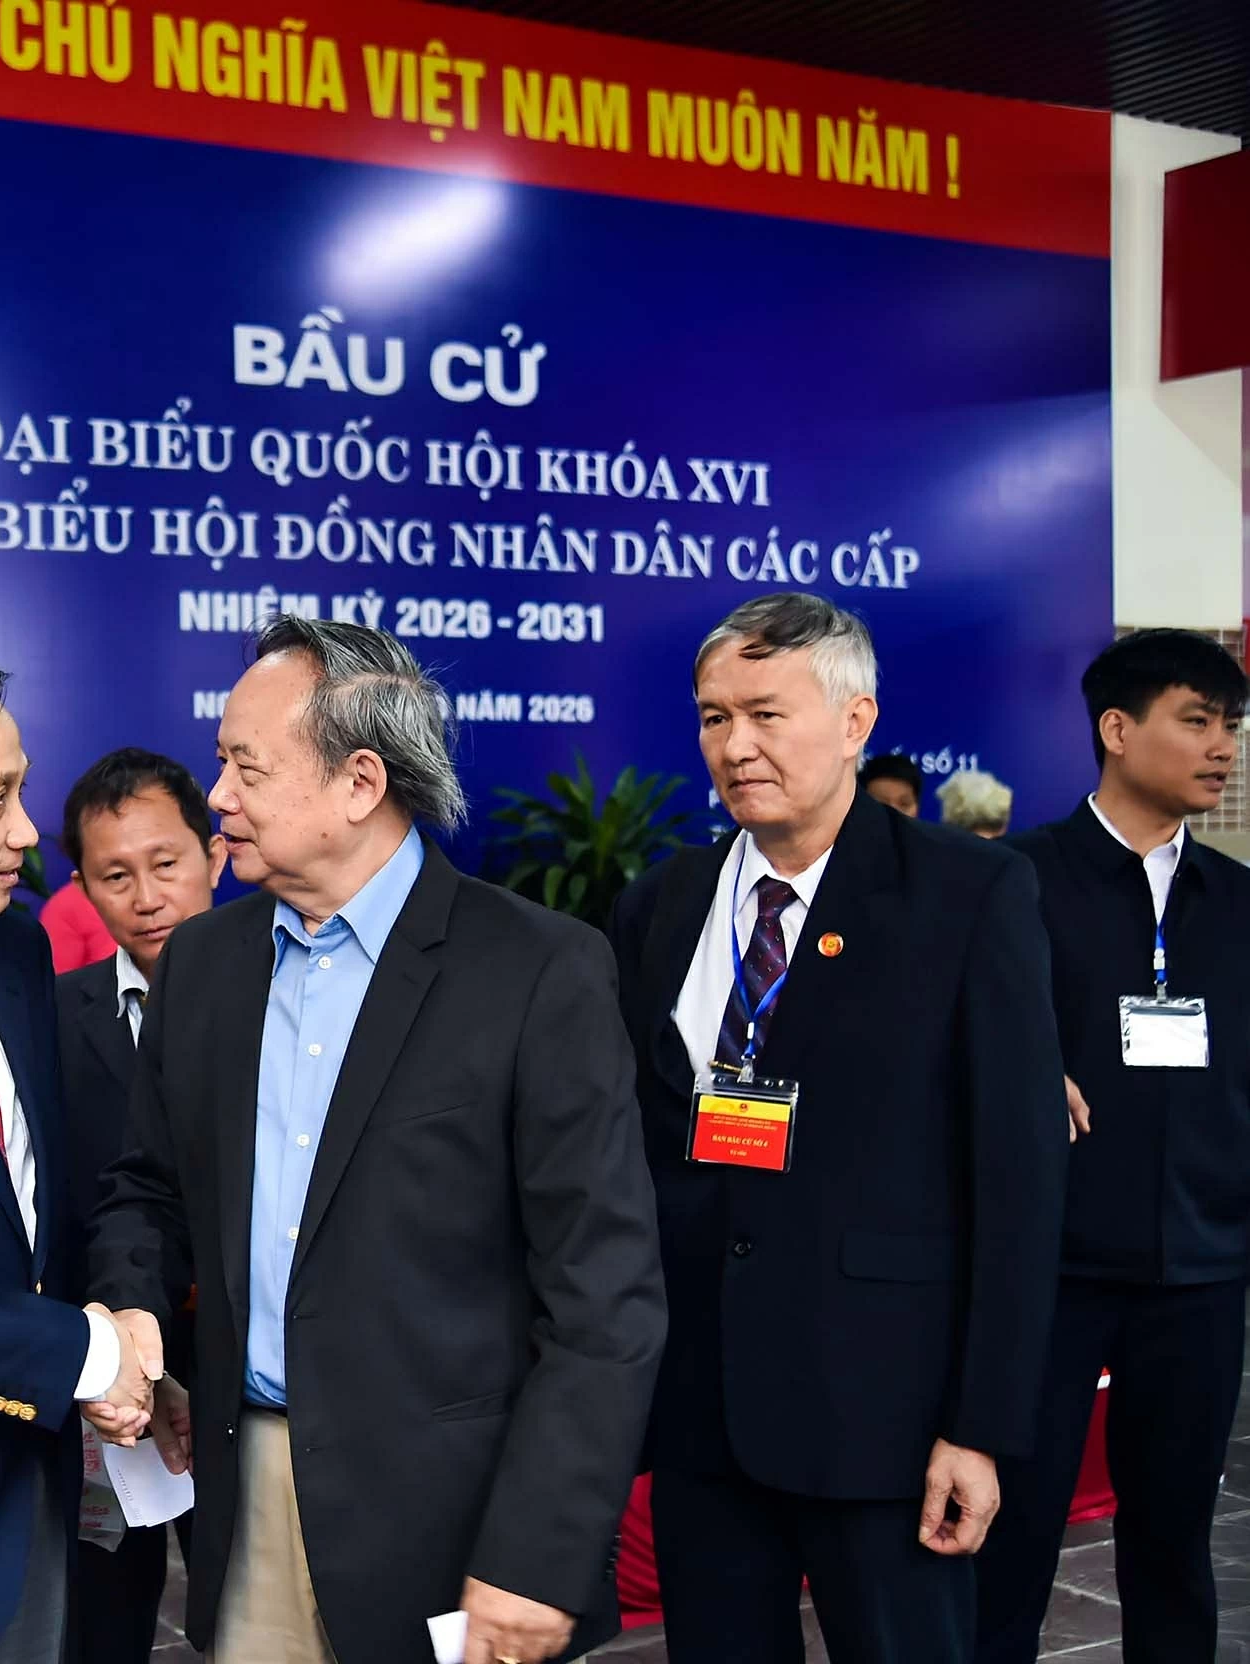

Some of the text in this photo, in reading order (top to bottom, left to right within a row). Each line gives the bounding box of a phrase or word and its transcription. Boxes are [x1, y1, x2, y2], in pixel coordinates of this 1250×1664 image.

[153, 15, 347, 113] NGHĨA
[362, 39, 485, 143] VIỆT
[503, 66, 630, 153] NAM
[648, 89, 802, 177] MUÔN
[817, 107, 928, 195] NĂM
[946, 134, 959, 199] !
[234, 306, 547, 407] BẦU CỬ
[89, 398, 235, 473] BIỂU
[251, 417, 410, 486] QUỐC
[426, 428, 523, 500] HỘI
[537, 442, 679, 500] KHÓA
[687, 458, 771, 506] XVI
[151, 497, 260, 570] HỘI
[274, 495, 435, 565] ĐỒNG
[450, 514, 598, 573] NHÂN
[611, 521, 713, 578] DÂN
[726, 527, 819, 584] CÁC
[831, 528, 921, 589] CẤP
[395, 597, 493, 639] 2026
[516, 602, 604, 642] 2031
[456, 688, 522, 722] NĂM
[528, 694, 594, 723] 2026
[921, 745, 953, 774] SỐ
